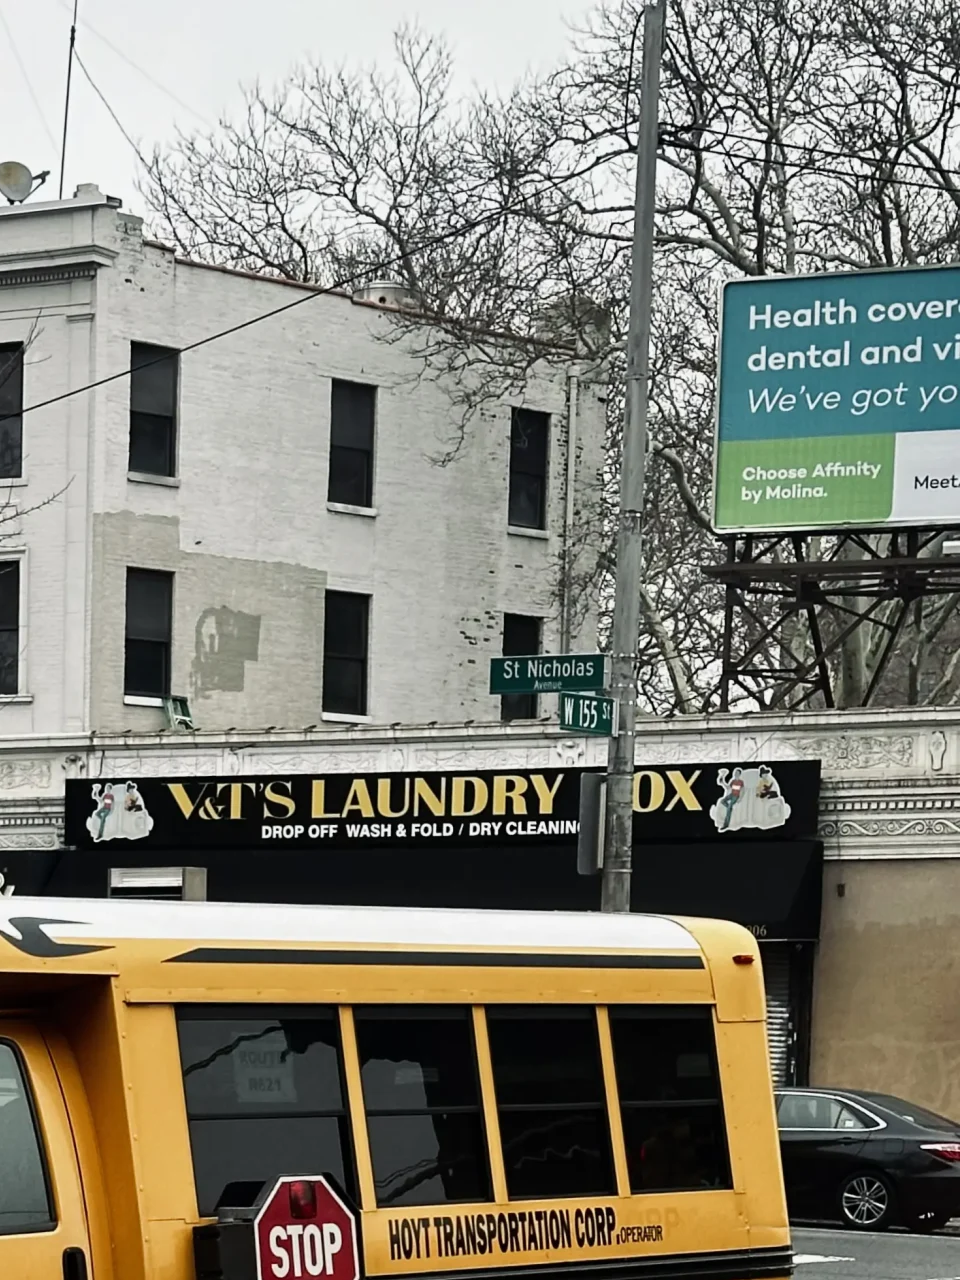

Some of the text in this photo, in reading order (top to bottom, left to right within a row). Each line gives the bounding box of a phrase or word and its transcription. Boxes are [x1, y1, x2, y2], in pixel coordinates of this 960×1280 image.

[748, 298, 960, 330] Health cover
[747, 340, 850, 372] dental
[860, 336, 922, 365] and
[748, 382, 959, 416] We've got yo
[742, 461, 881, 481] Choose Affinity
[914, 474, 960, 490] Meet
[741, 483, 828, 504] by Molina.
[503, 659, 594, 679] St Nicholas
[533, 680, 562, 690] Avenue
[564, 697, 611, 728] W 155 St
[311, 775, 565, 819] LAUNDRY
[632, 770, 703, 812] OX
[261, 825, 304, 839] DROP
[308, 824, 338, 838] OFF
[346, 823, 392, 837] WASH
[395, 823, 407, 837] &
[411, 823, 454, 837] FOLD
[469, 822, 503, 836] DRY
[506, 820, 581, 836] CLEANIN
[389, 1217, 430, 1260] HOYT
[433, 1208, 572, 1258] TRANSPORTATION
[269, 1222, 342, 1278] STOP
